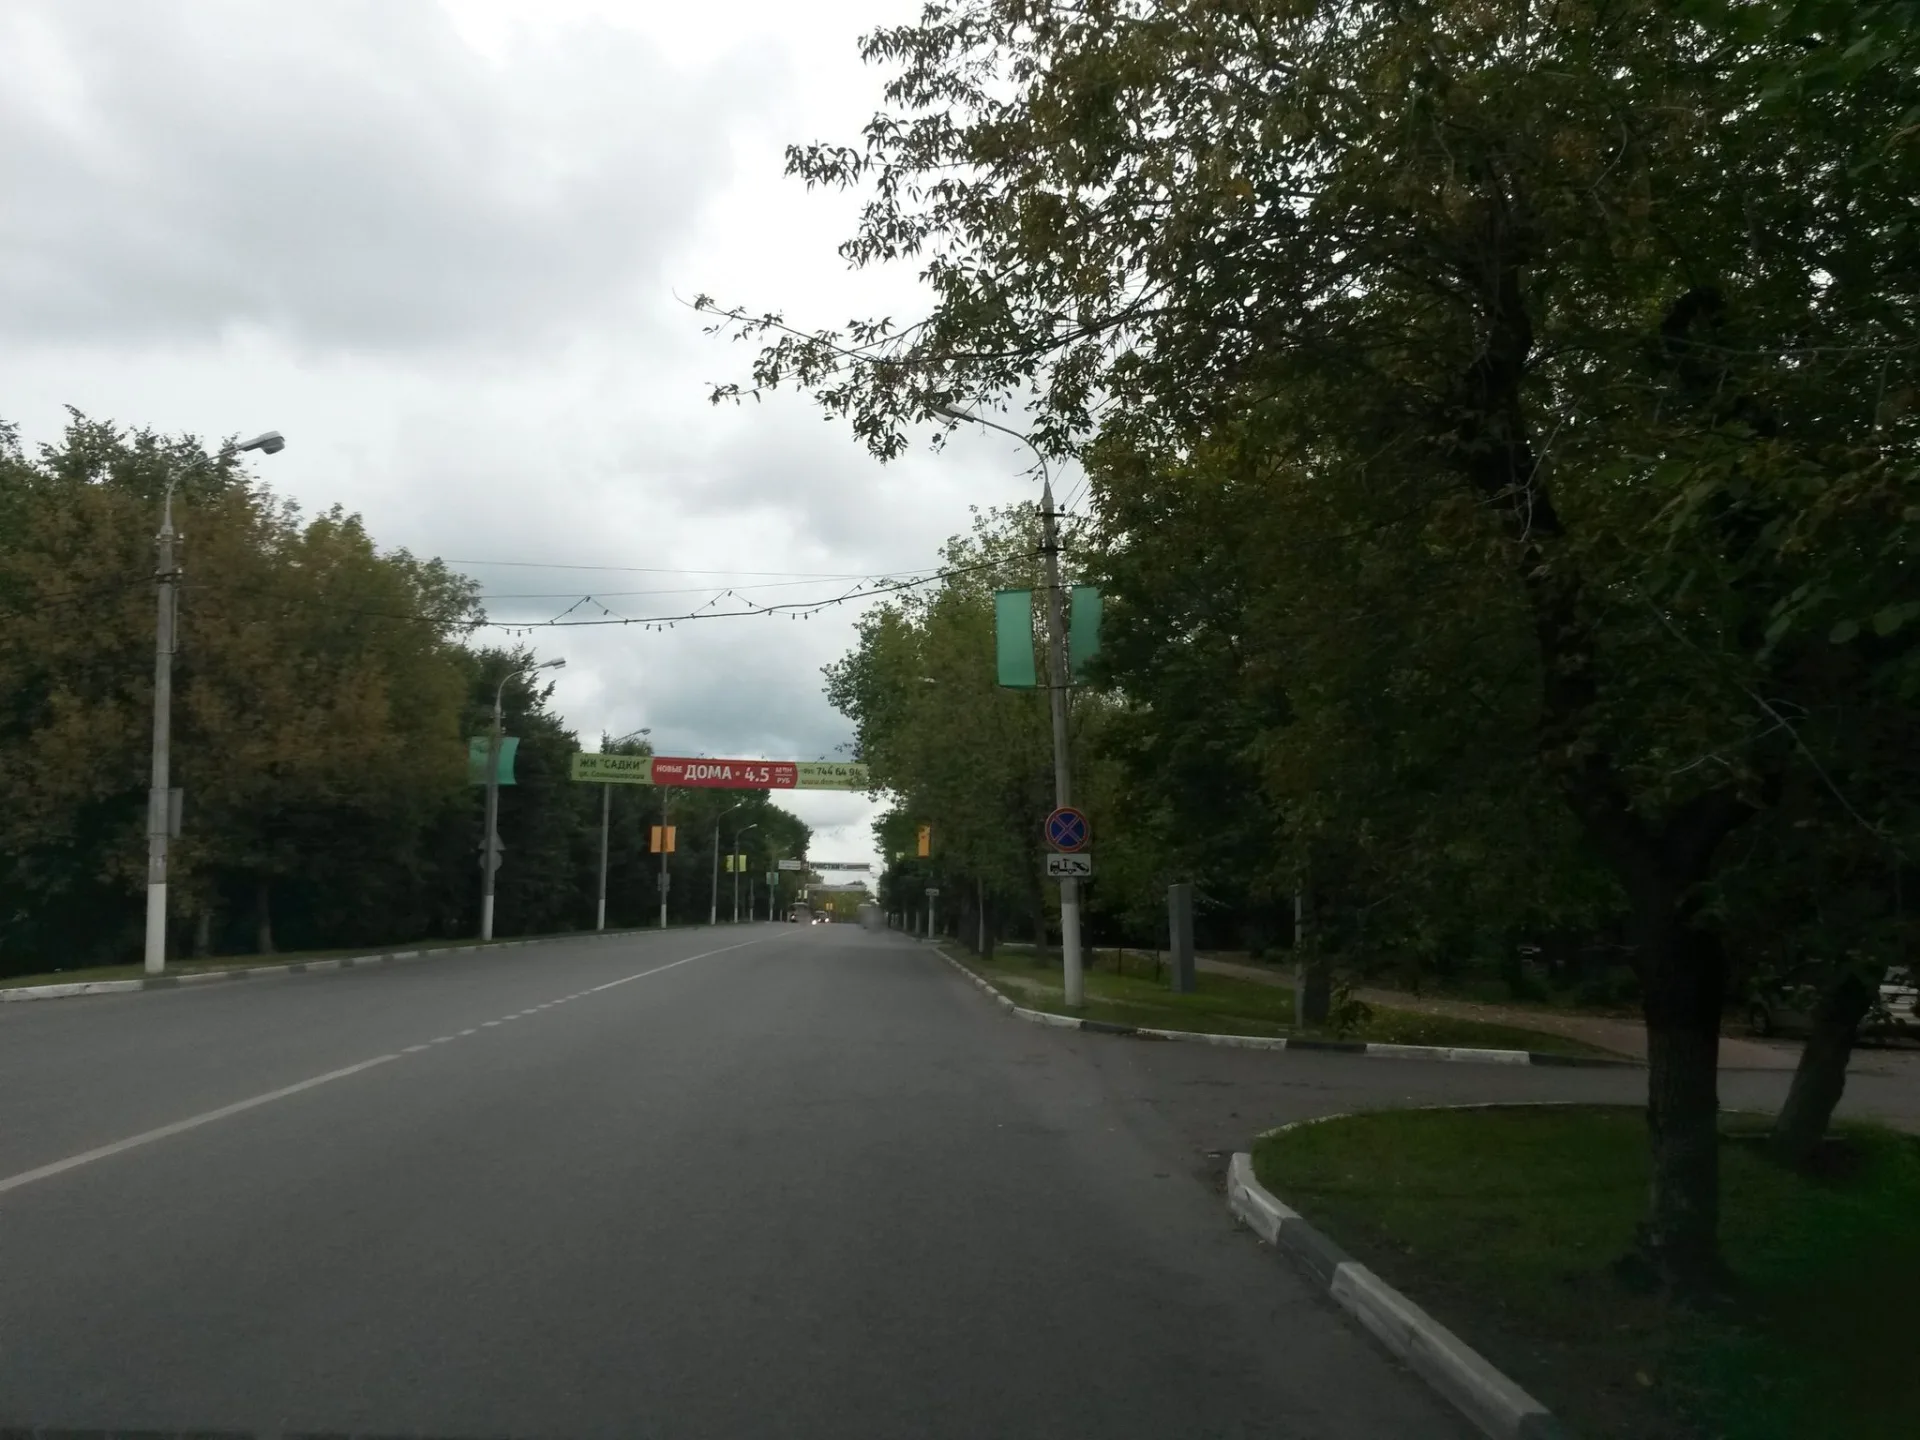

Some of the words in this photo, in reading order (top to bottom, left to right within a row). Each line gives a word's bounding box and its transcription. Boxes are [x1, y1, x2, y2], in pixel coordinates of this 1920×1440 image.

[656, 764, 683, 773] НОВЫЕ
[683, 764, 732, 781] ДОМА
[744, 767, 770, 783] 4.5
